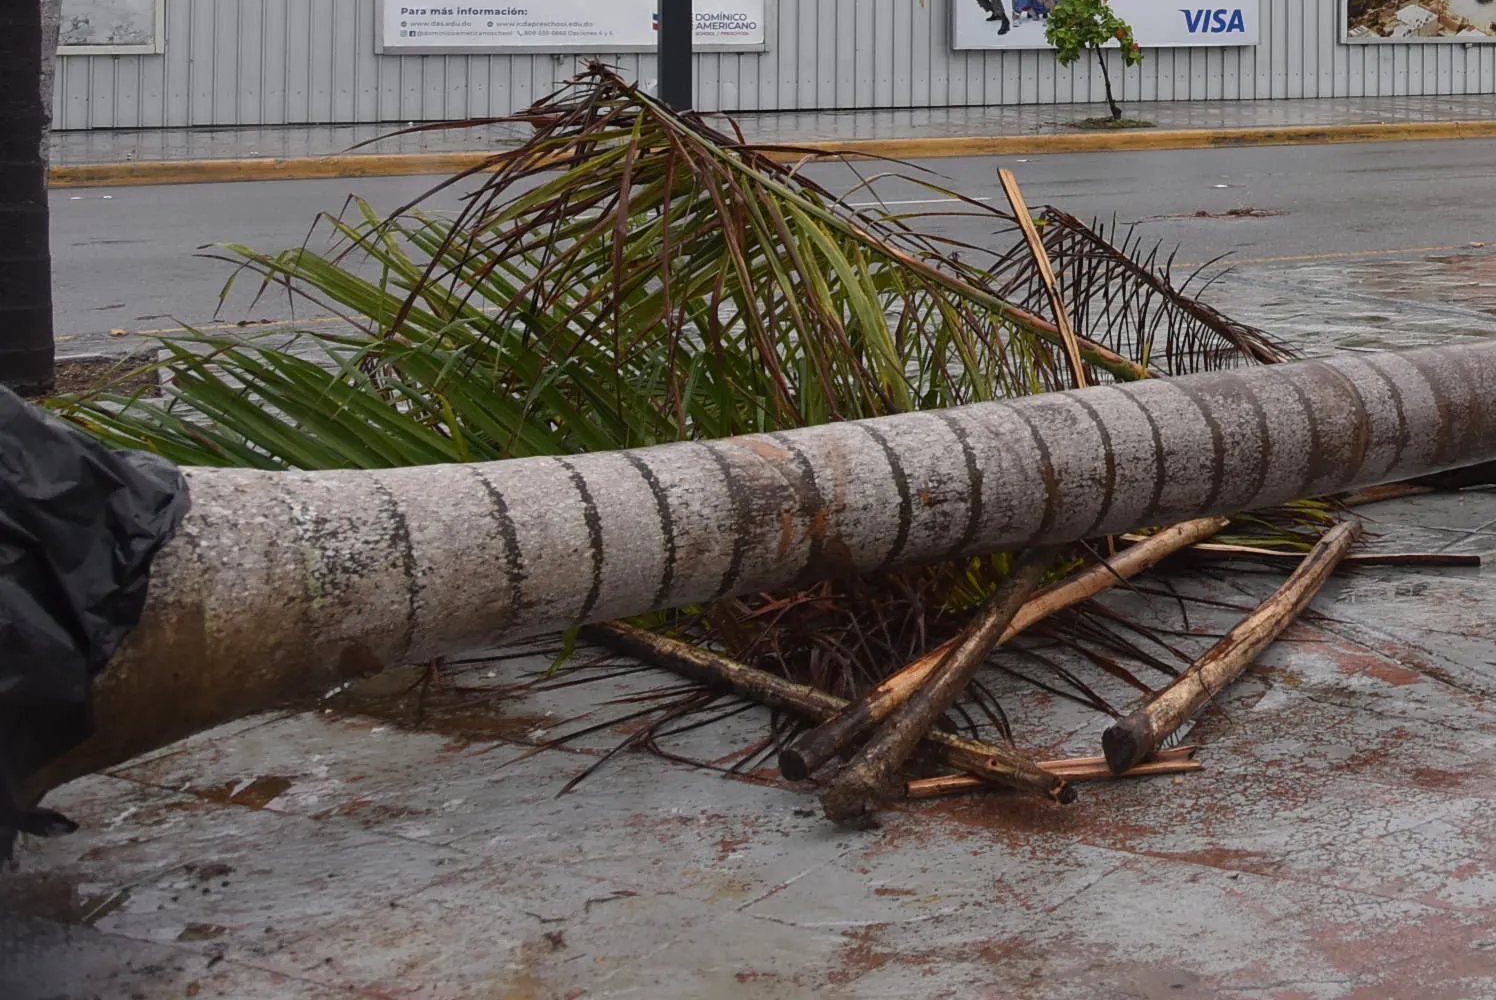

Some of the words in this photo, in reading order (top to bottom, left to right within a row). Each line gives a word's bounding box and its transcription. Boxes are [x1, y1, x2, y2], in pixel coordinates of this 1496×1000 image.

[401, 7, 427, 15] Para
[430, 7, 454, 15] más
[457, 6, 528, 16] información:
[1178, 8, 1245, 33] VISA
[695, 22, 756, 30] AMERICANO
